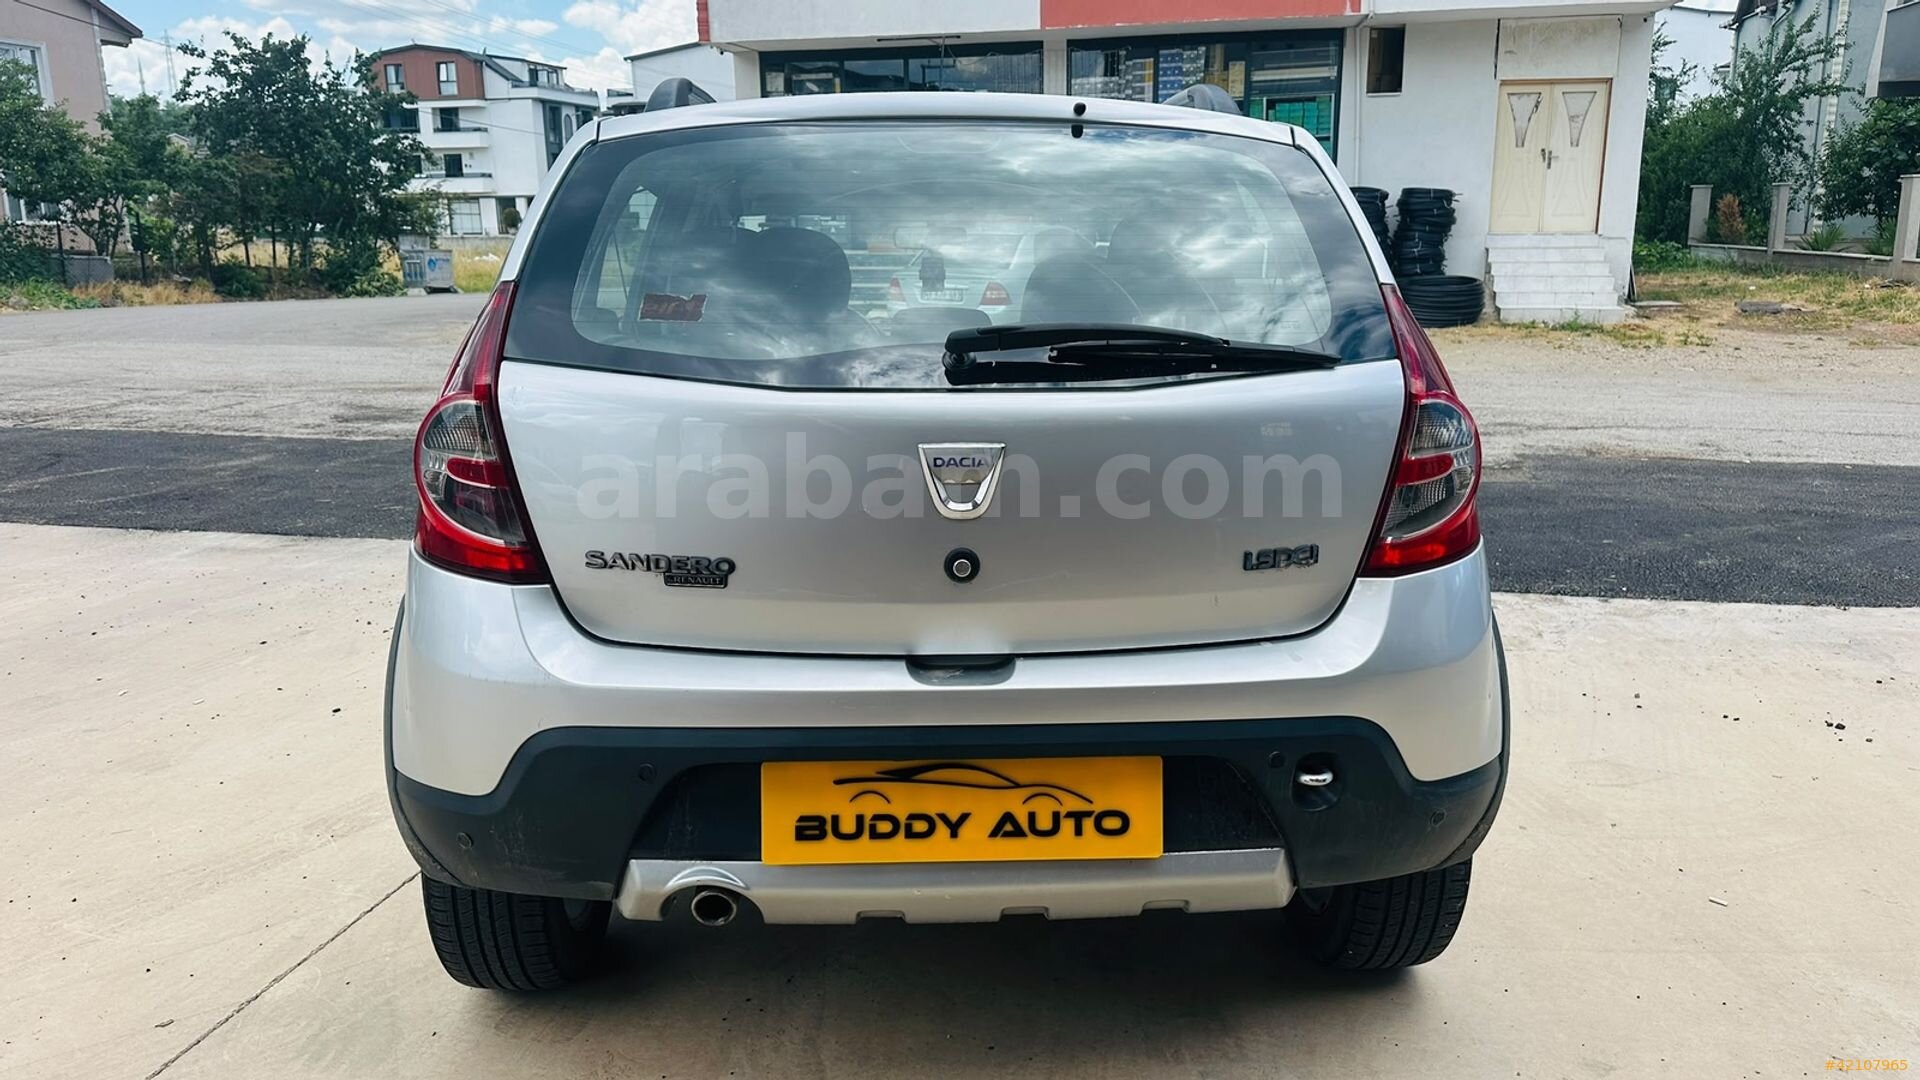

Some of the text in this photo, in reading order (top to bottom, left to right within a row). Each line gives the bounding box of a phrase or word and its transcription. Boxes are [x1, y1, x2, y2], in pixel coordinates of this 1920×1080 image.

[933, 457, 990, 469] DACIA
[585, 550, 736, 576] SANDERO
[673, 576, 721, 585] RENAULT
[795, 810, 1131, 841] BUDDY AUTO
